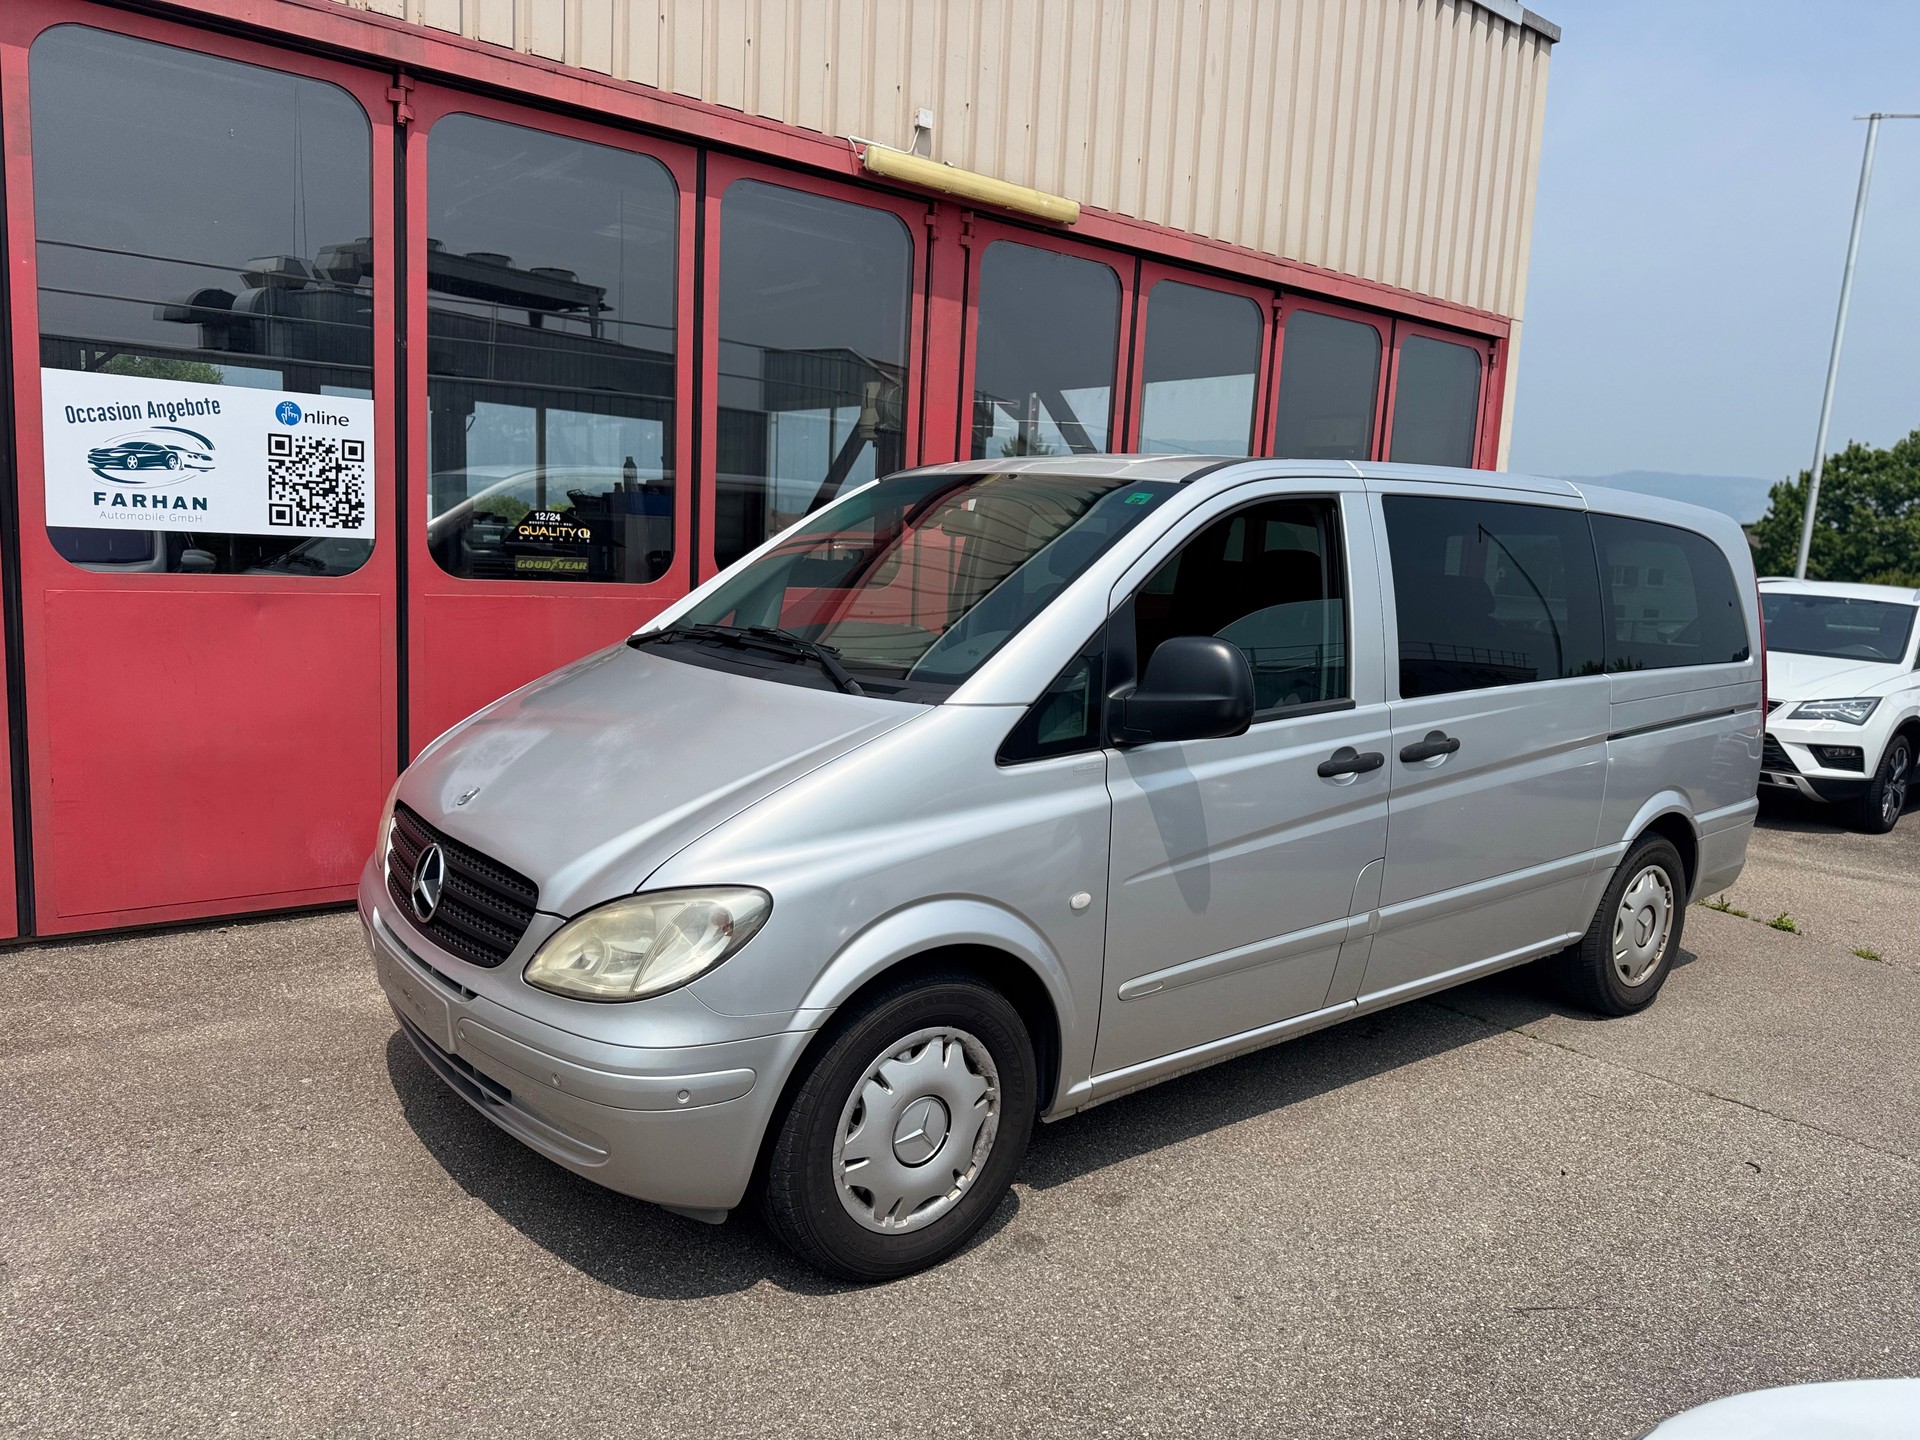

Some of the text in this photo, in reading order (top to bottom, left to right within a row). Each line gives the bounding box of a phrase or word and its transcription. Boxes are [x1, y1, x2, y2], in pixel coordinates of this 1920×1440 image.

[64, 397, 221, 424] Occasion Angebote
[93, 491, 208, 511] FARHAN
[99, 510, 203, 523] Automobile GmbH
[535, 512, 561, 521] 12/24
[517, 558, 587, 570] GOODYEAR
